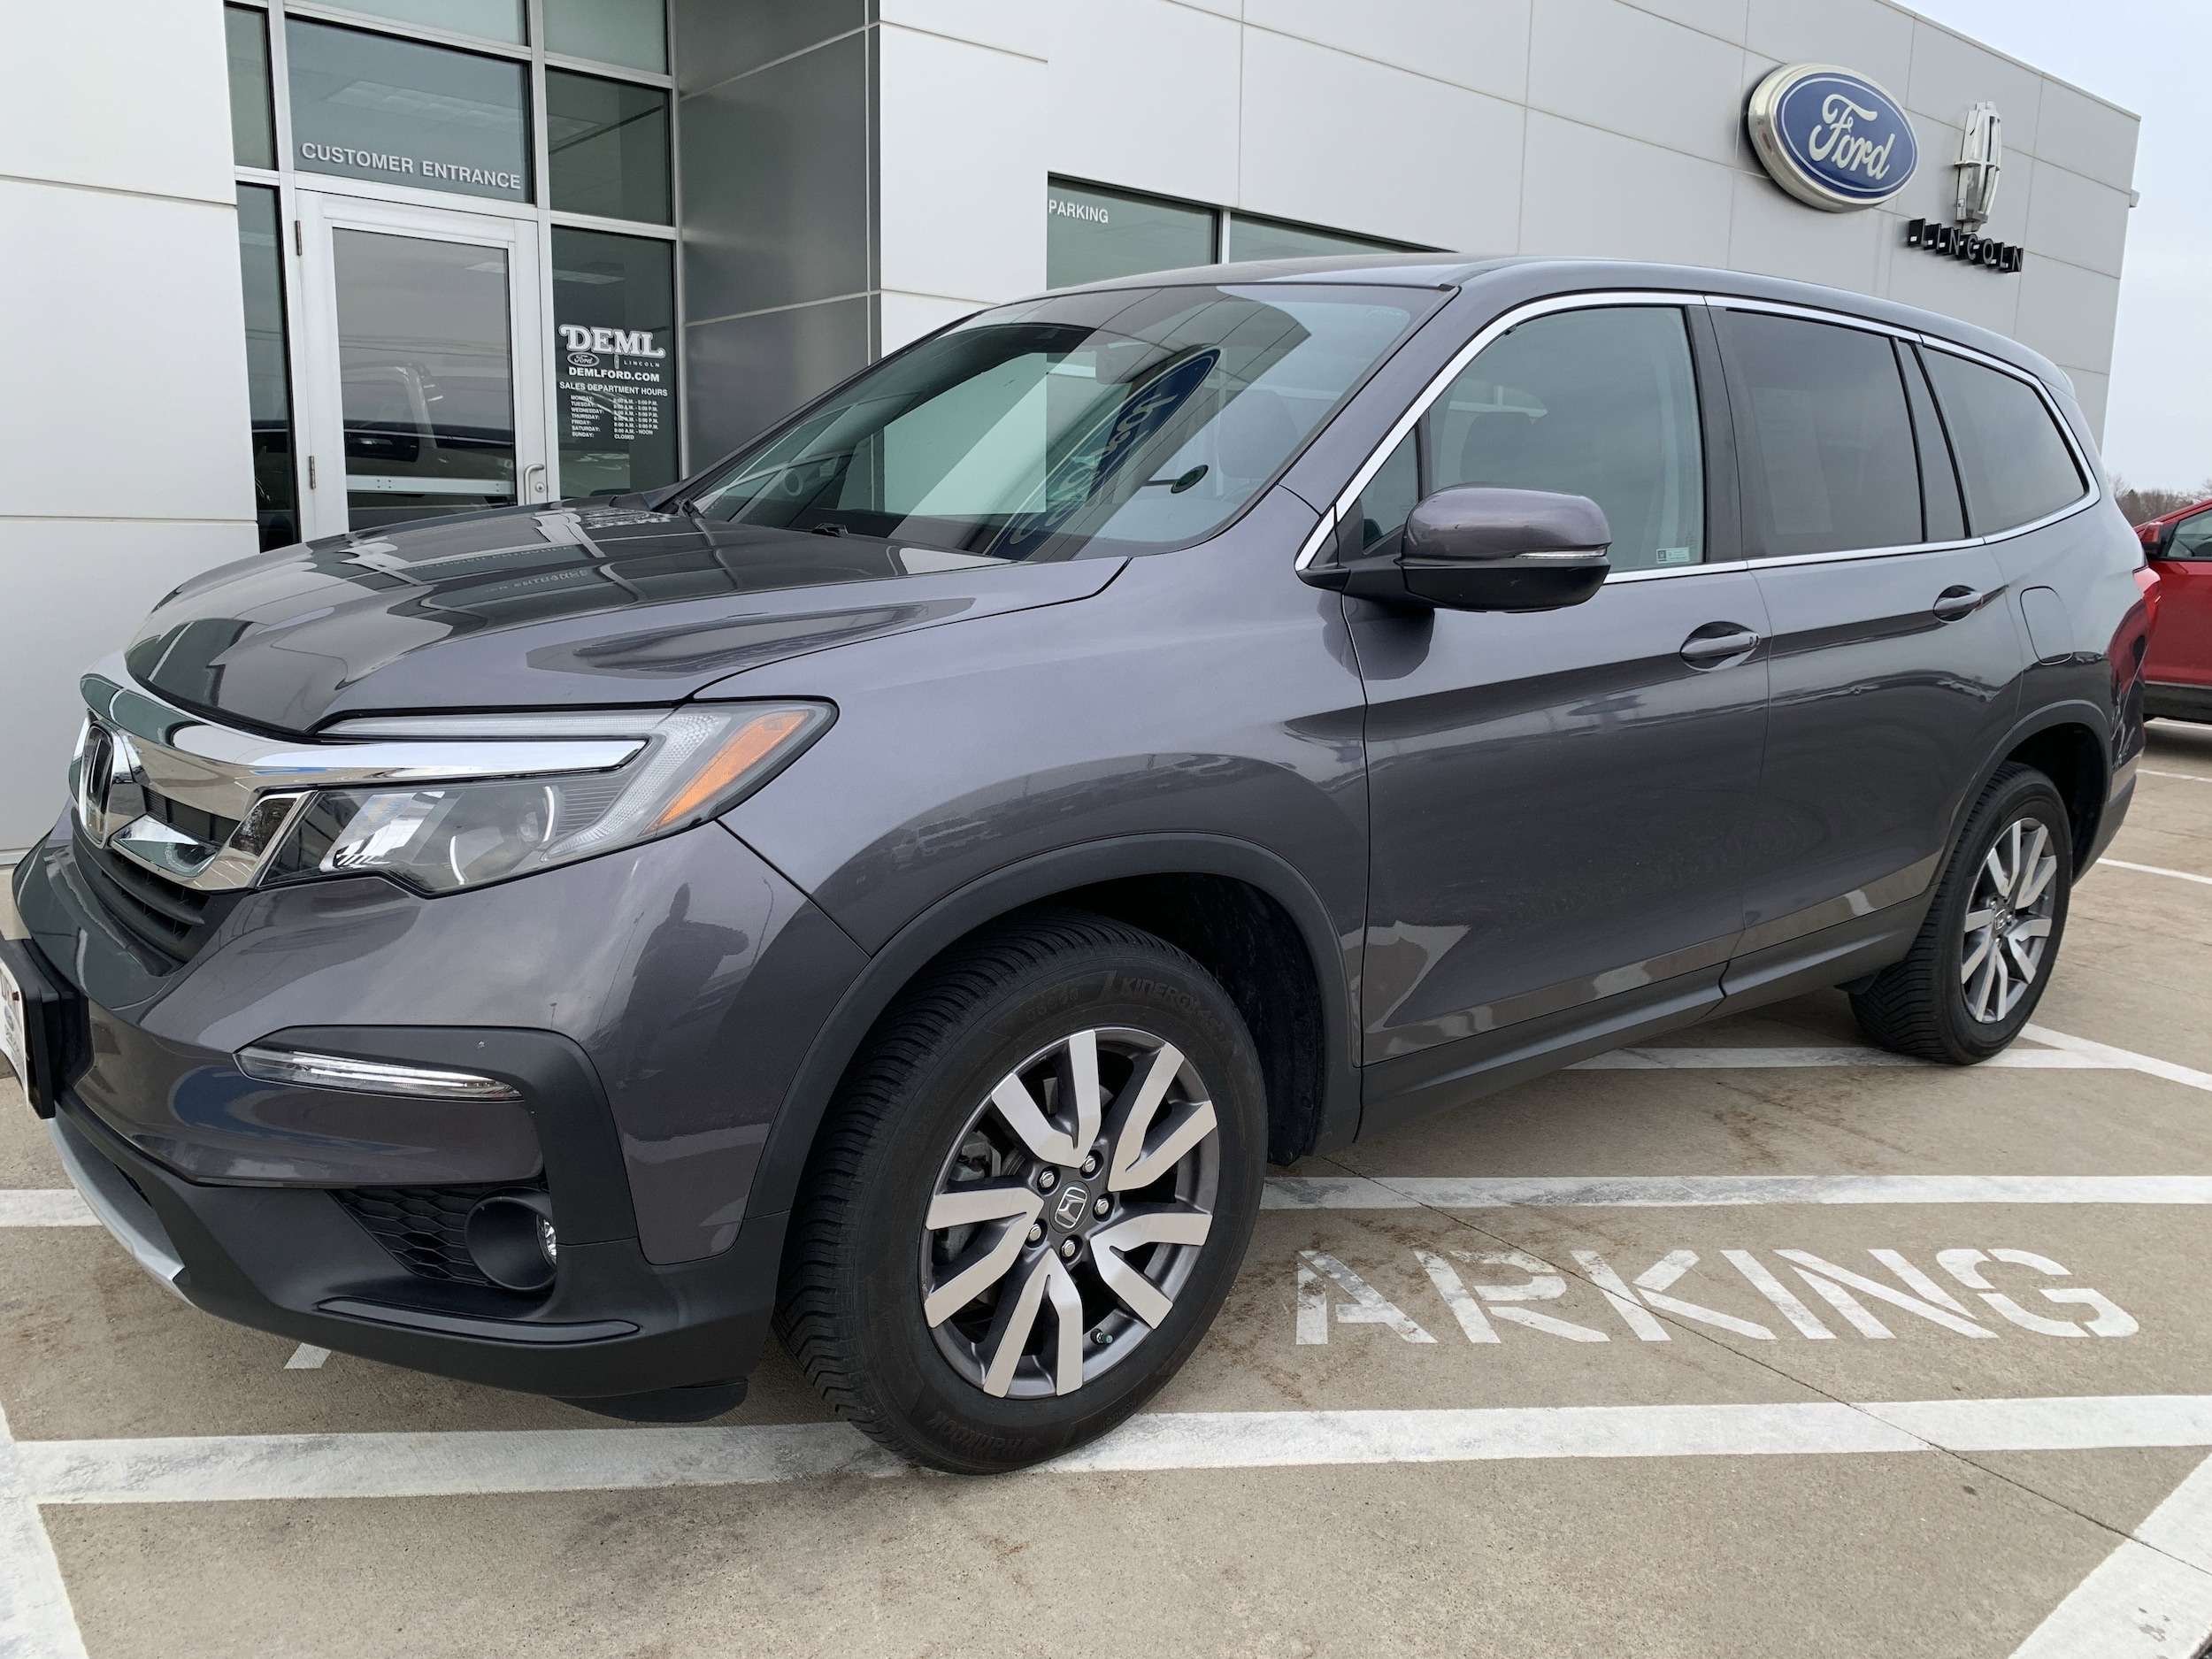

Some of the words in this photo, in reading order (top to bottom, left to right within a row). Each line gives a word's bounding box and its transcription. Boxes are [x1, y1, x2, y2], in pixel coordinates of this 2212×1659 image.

[1809, 93, 1895, 180] Ford
[301, 142, 413, 173] CUSTOMER
[421, 160, 522, 190] ENTRANCE
[1048, 199, 1109, 224] PARKING
[558, 324, 666, 359] DEML
[568, 366, 660, 382] DEMLFORD.COM
[624, 359, 660, 368] LINCOLN
[559, 380, 586, 391] SALES
[587, 383, 639, 395] DEPARTMENT
[641, 387, 668, 397] HOURS
[1296, 1248, 2140, 1345] ARKING
